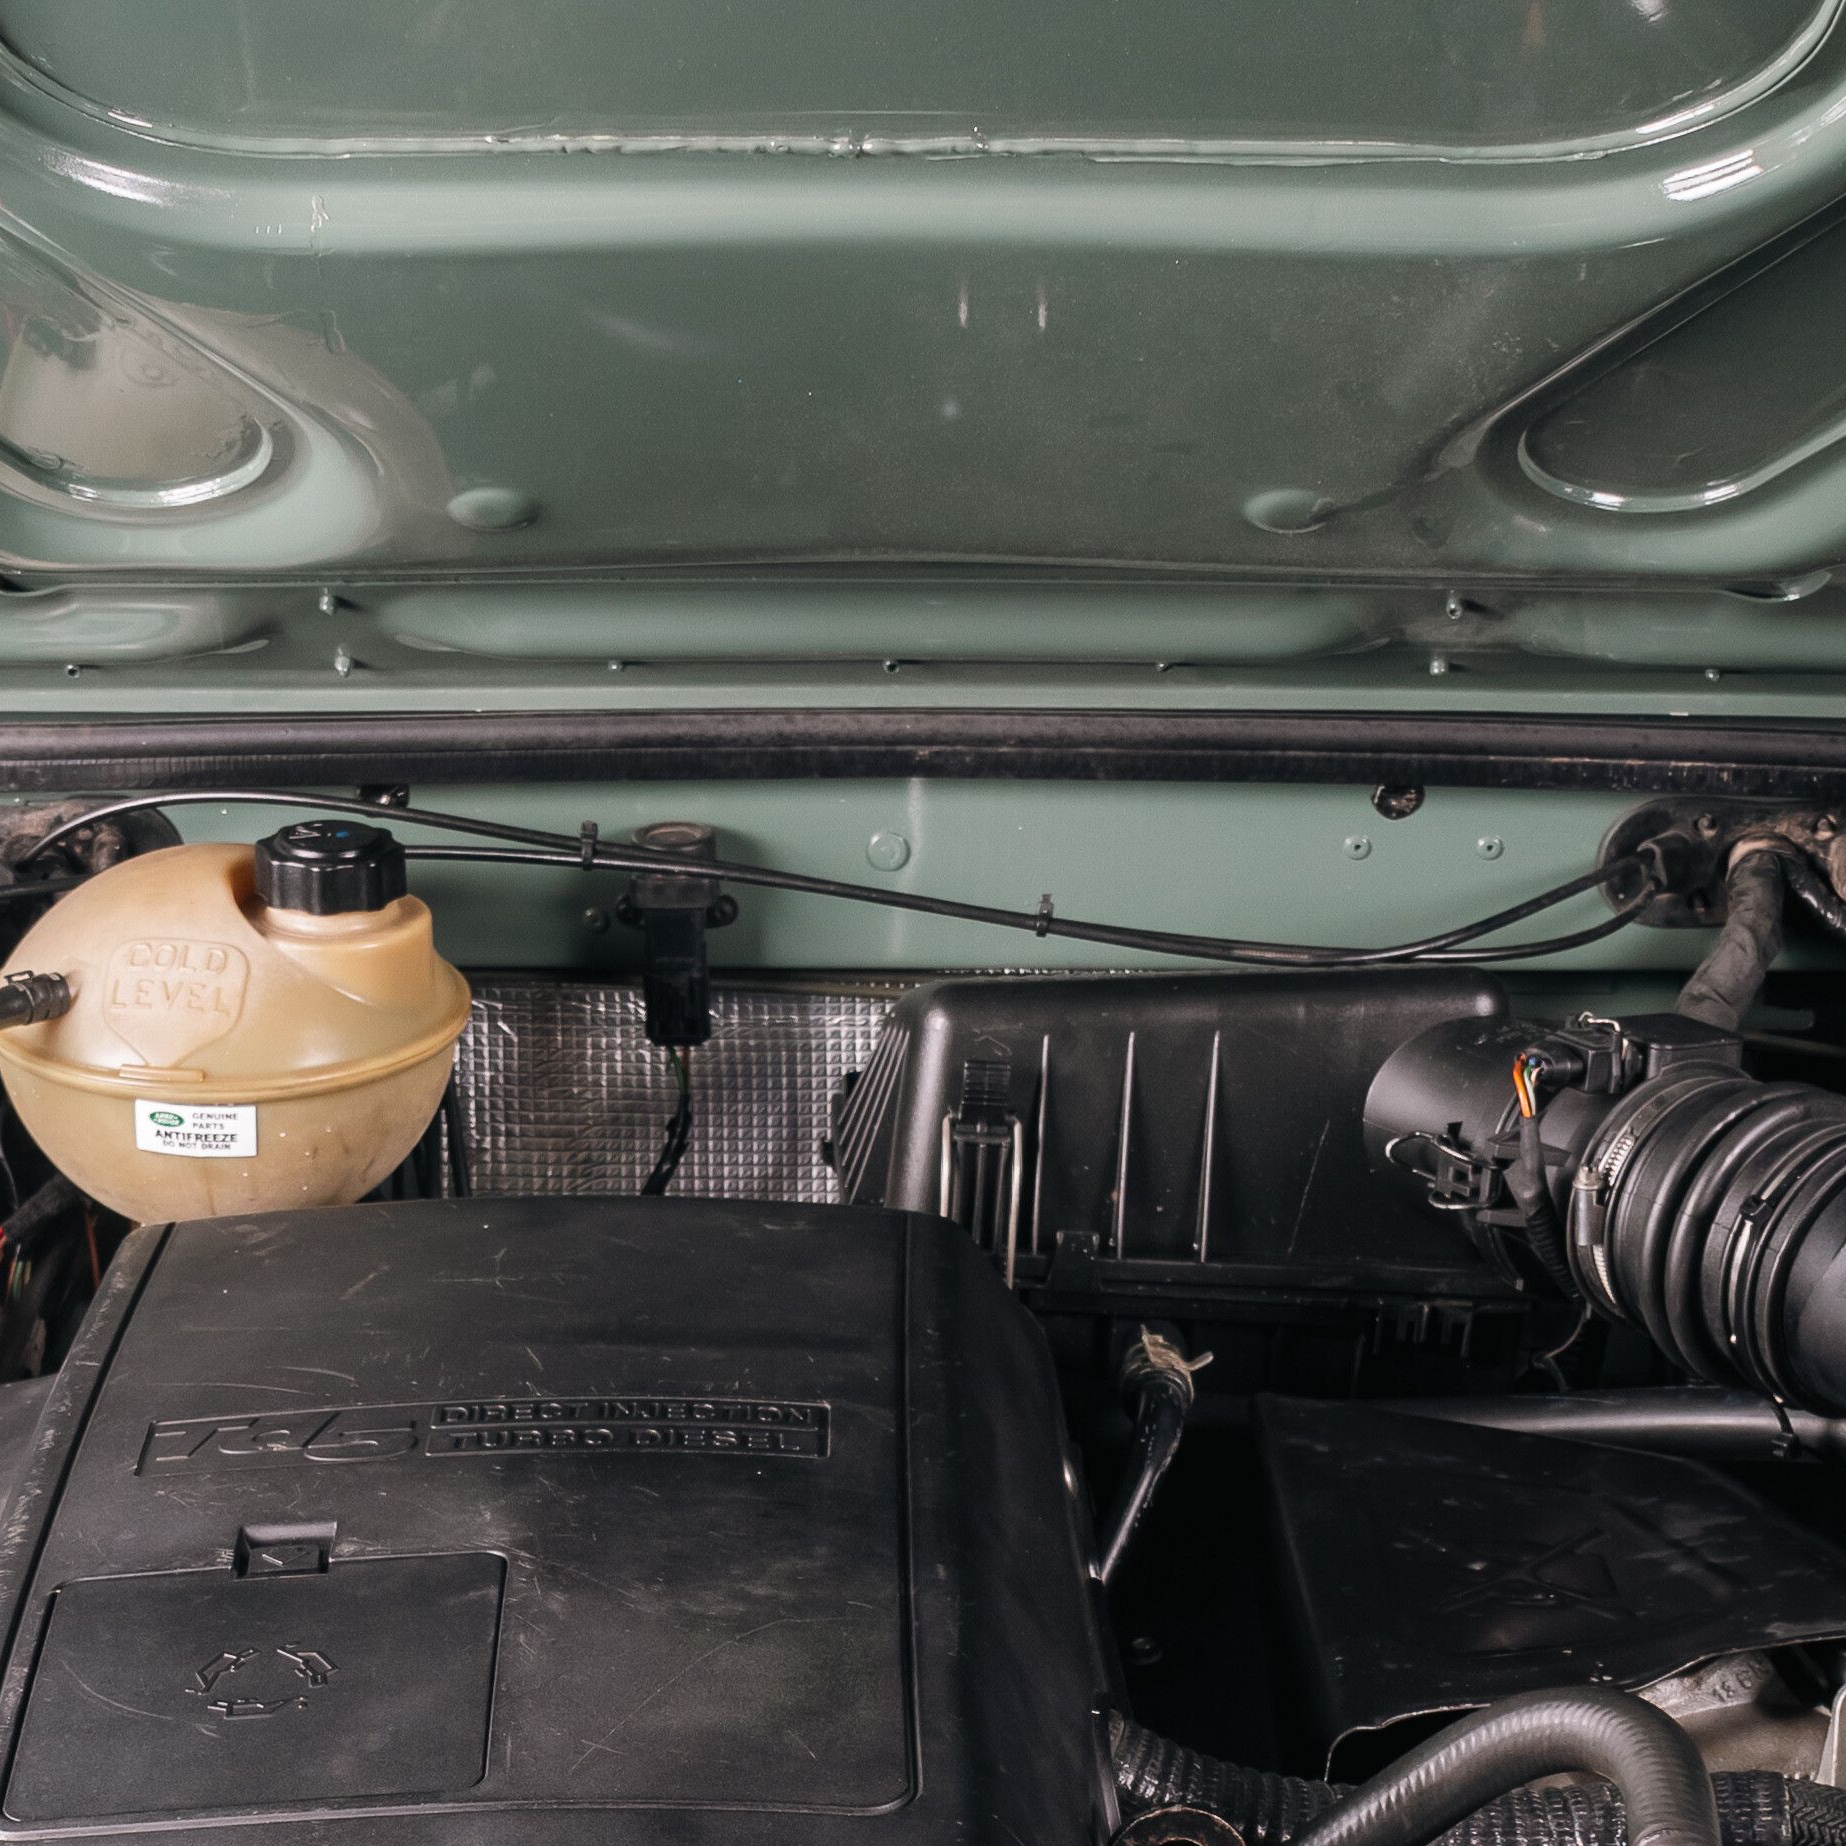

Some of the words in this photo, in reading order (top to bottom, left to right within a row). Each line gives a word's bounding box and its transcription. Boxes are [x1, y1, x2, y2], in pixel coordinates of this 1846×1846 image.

[129, 943, 229, 973] COLD
[111, 977, 230, 1016] LEVEL
[192, 1112, 238, 1120] GENUINE
[192, 1122, 225, 1130] PARTS
[155, 1130, 238, 1143] ANTIFREEZE
[201, 1142, 231, 1151] DRAIN
[441, 1402, 588, 1424] DIRECT
[599, 1402, 813, 1424] INJECTION
[448, 1428, 613, 1449] TURBO
[629, 1428, 801, 1452] DIESEL
